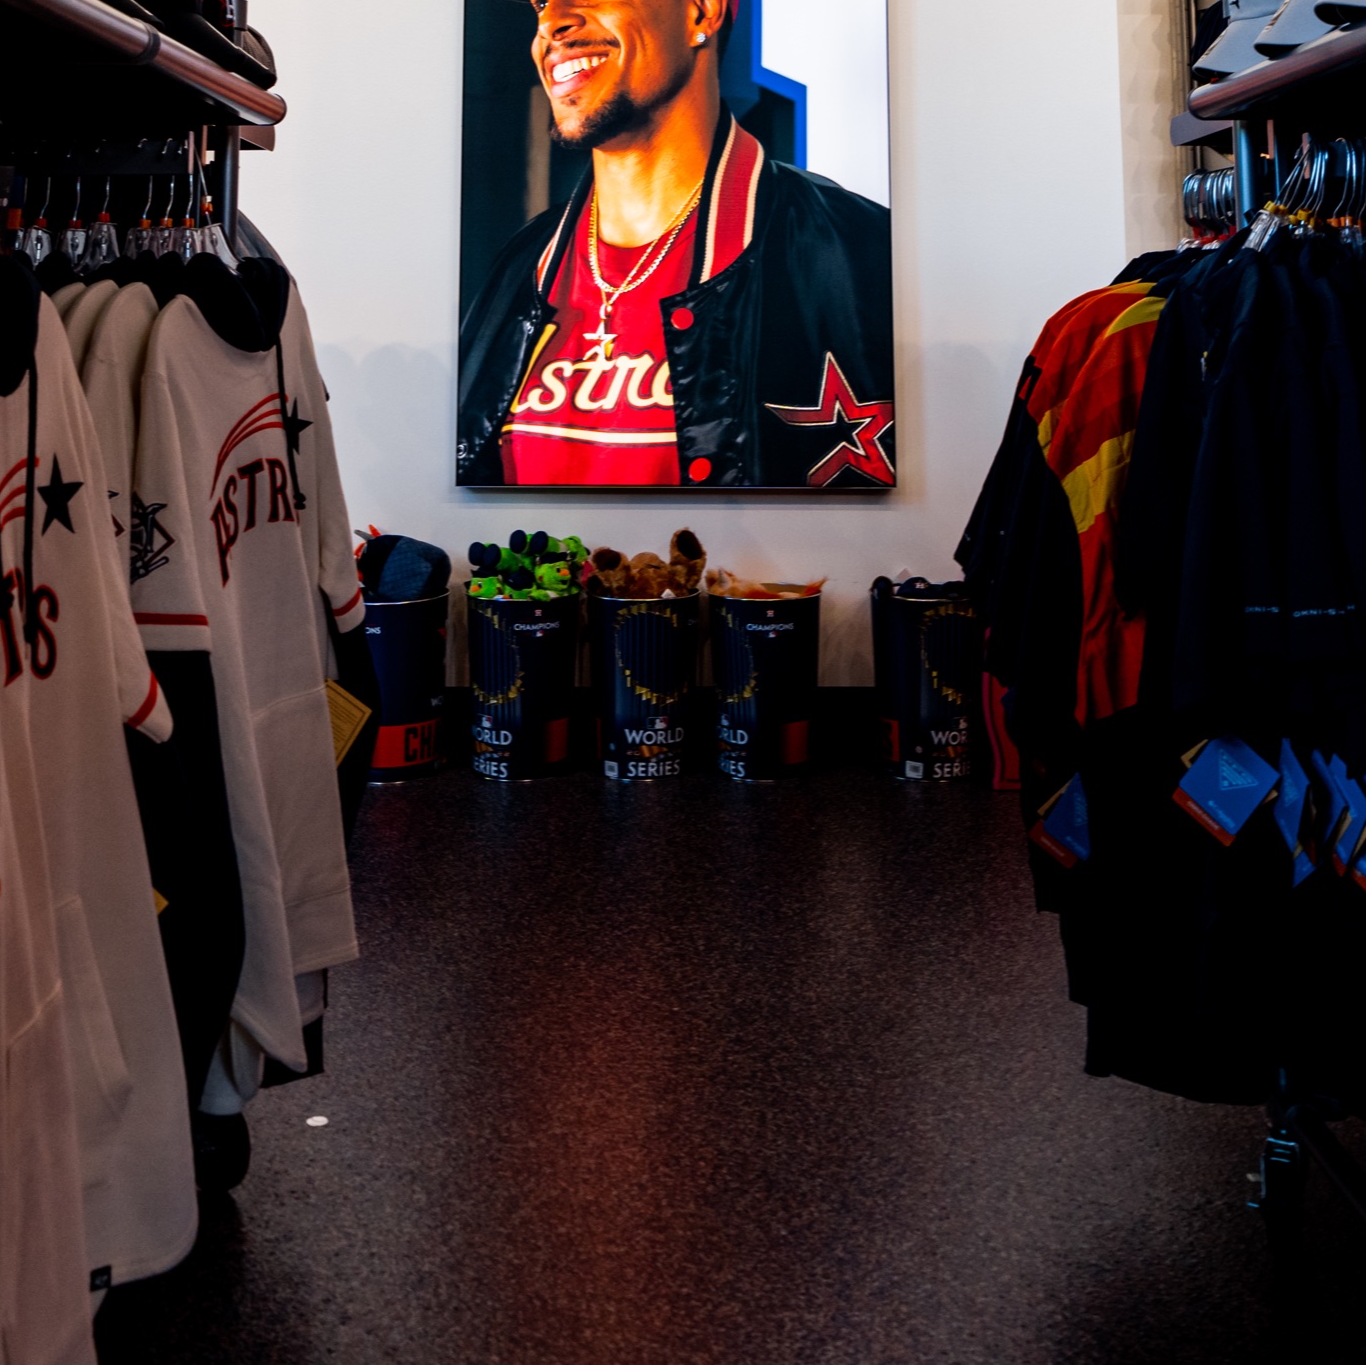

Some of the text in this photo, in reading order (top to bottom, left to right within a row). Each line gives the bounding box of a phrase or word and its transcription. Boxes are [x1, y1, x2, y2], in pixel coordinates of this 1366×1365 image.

[513, 621, 560, 631] CHAMPIONS
[746, 622, 794, 631] CHAMPIONS
[624, 727, 684, 745] WORLD
[626, 759, 681, 777] SERIES
